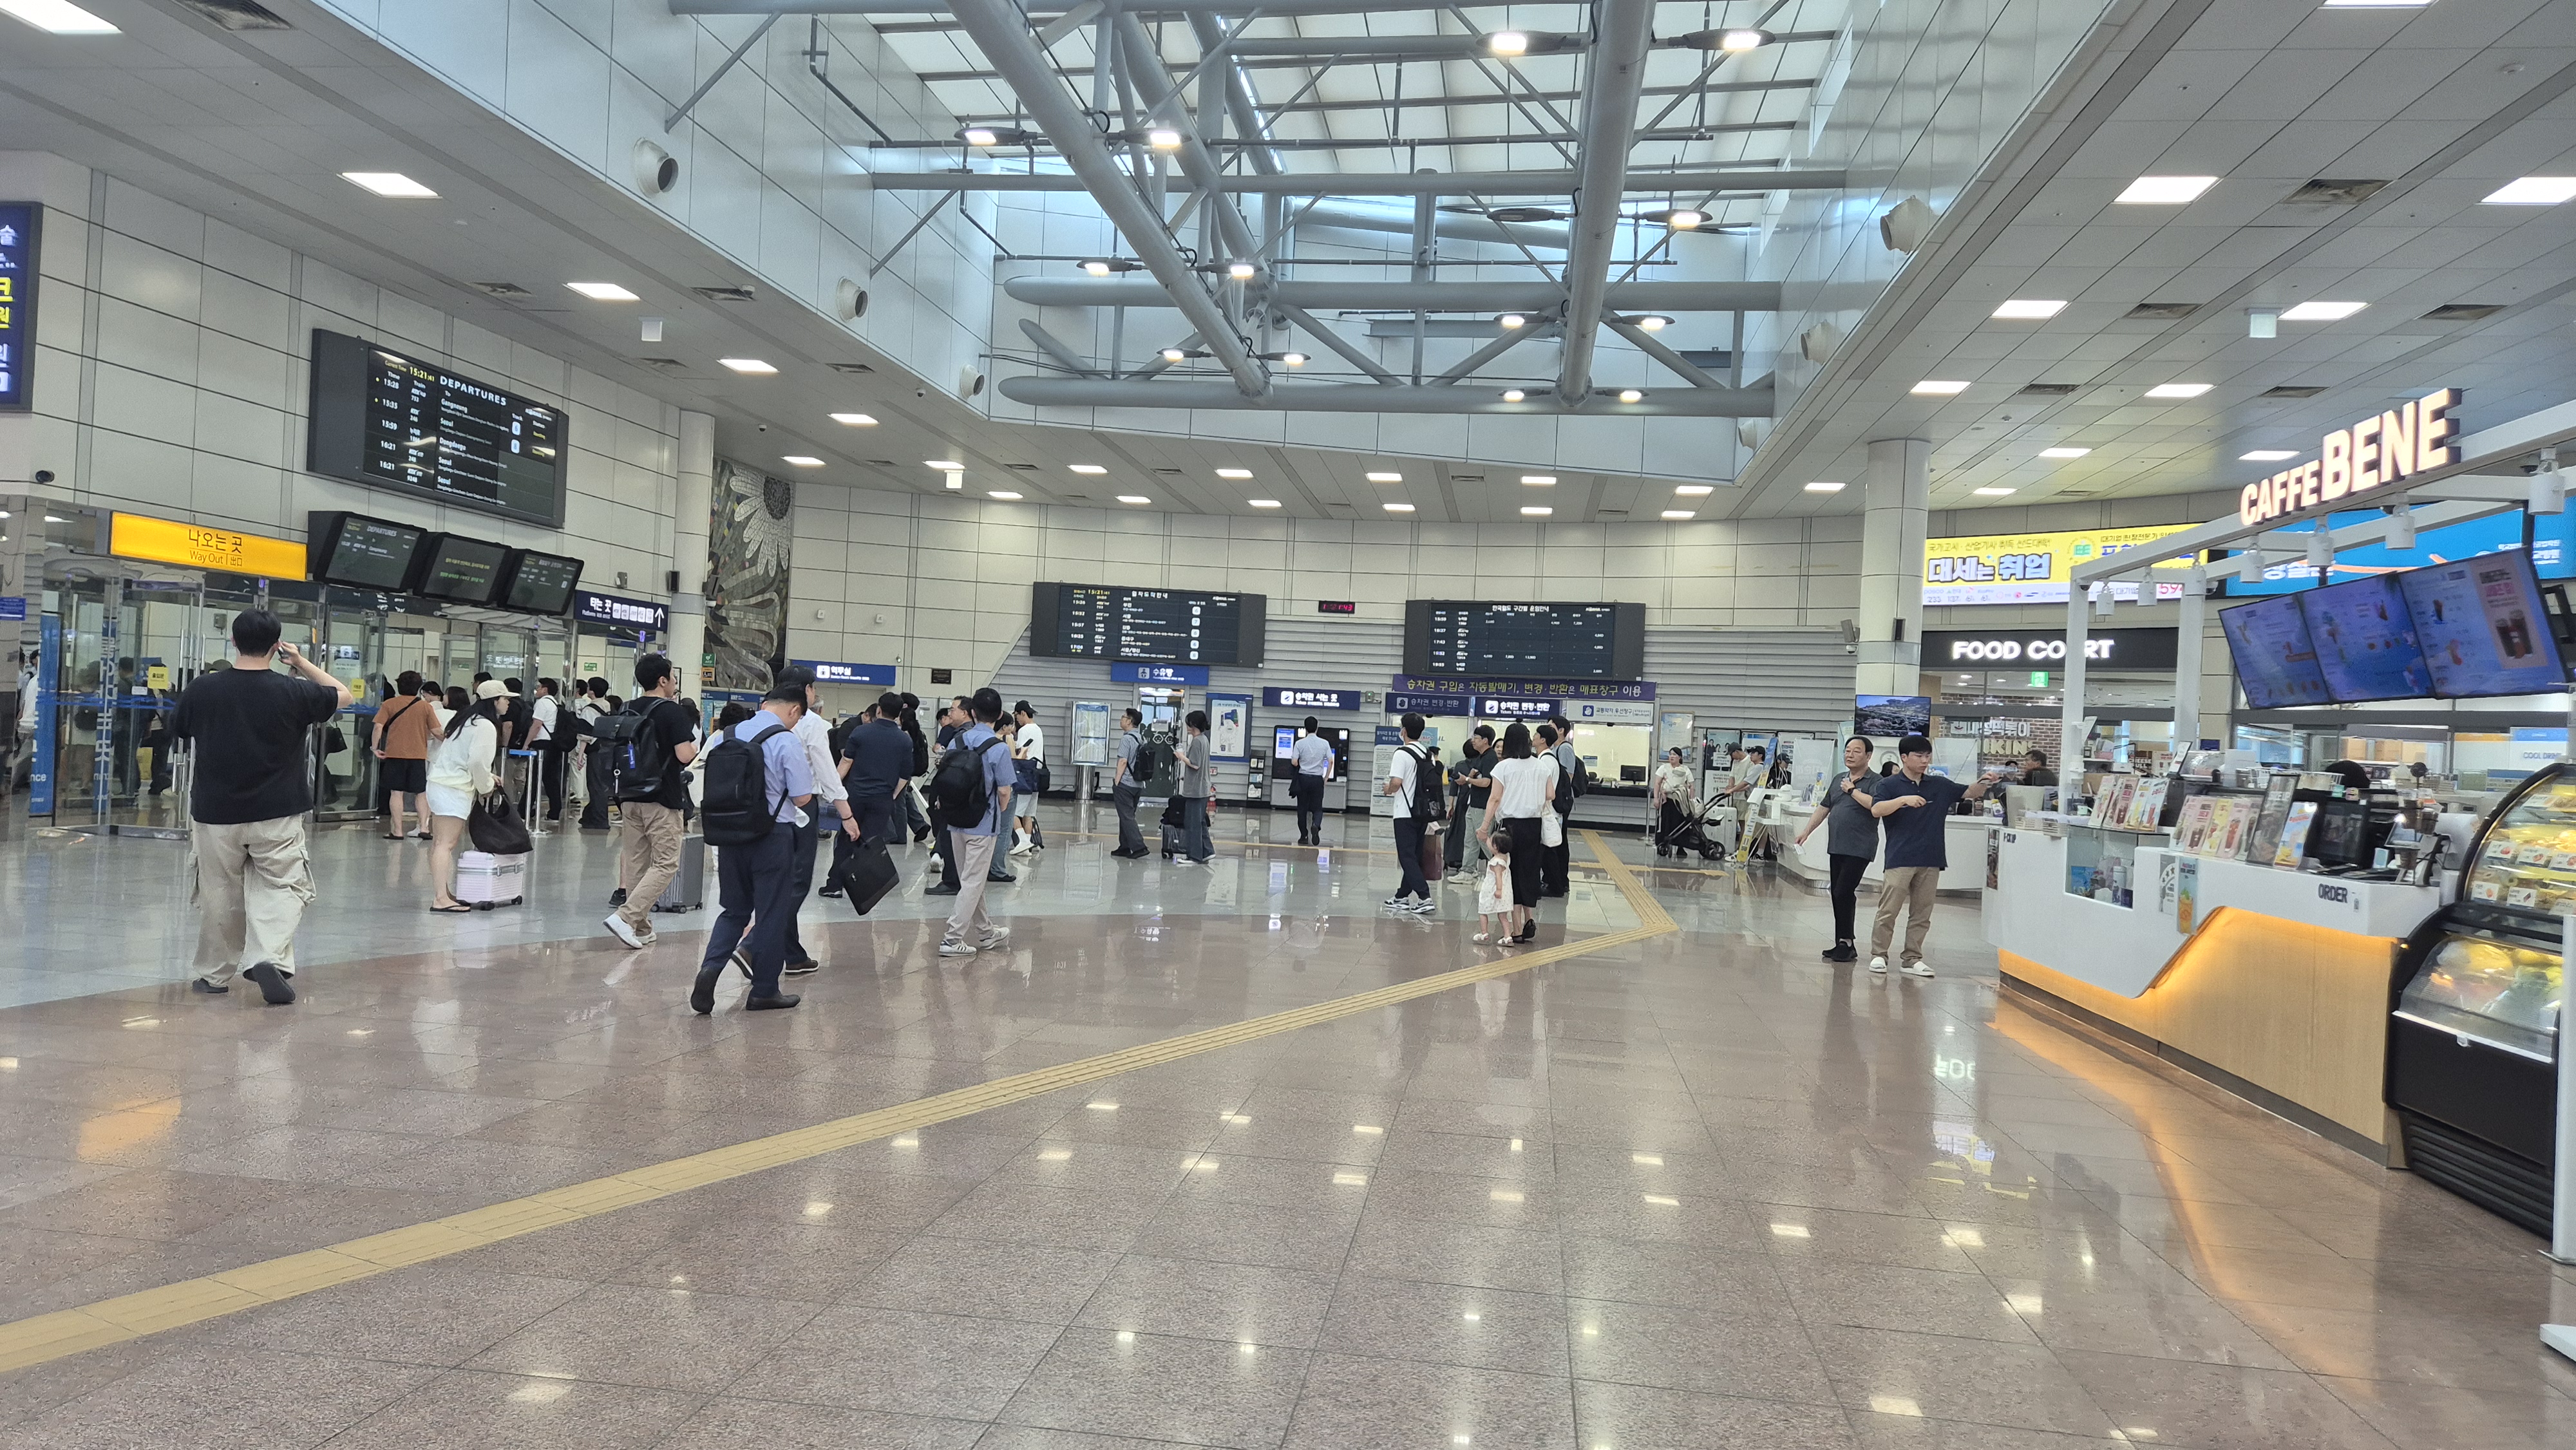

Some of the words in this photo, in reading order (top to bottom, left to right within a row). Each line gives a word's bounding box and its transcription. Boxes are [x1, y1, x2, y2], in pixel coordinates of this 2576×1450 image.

[440, 375, 507, 406] DEPARTURES
[382, 419, 398, 431] 15:59
[440, 417, 454, 428] Seoul
[381, 440, 396, 451] 16:21
[438, 456, 453, 466] Seoul
[2240, 459, 2321, 527] CAFFE
[2321, 388, 2461, 502] BENE
[379, 460, 395, 471] 16:21
[437, 475, 451, 485] Seoul
[366, 525, 397, 537] DEPARTURES
[189, 528, 227, 552] 나오는
[231, 535, 242, 554] 곳
[189, 550, 207, 564] Way
[208, 552, 223, 565] Out
[230, 556, 242, 567] 出口
[1926, 556, 1996, 583] 대세는
[1998, 552, 2052, 581] 취업
[604, 599, 612, 613] 곳
[1952, 640, 2022, 660] FOOD
[2027, 638, 2116, 660] CORT
[830, 666, 851, 676] 역무실
[1153, 667, 1174, 677] 수유방
[1406, 679, 1435, 691] 승차권
[1439, 680, 1465, 693] 구입은
[1468, 681, 1519, 694] 자동발매기,
[1579, 684, 1618, 697] 매표창구
[1622, 685, 1642, 697] 이용
[1295, 692, 1314, 701] 승차권
[1316, 693, 1329, 702] 사는
[1331, 693, 1338, 702] 곳
[1410, 698, 1429, 706] 승차권
[1500, 701, 1520, 711] 승차권
[2318, 883, 2348, 904] ORDER
